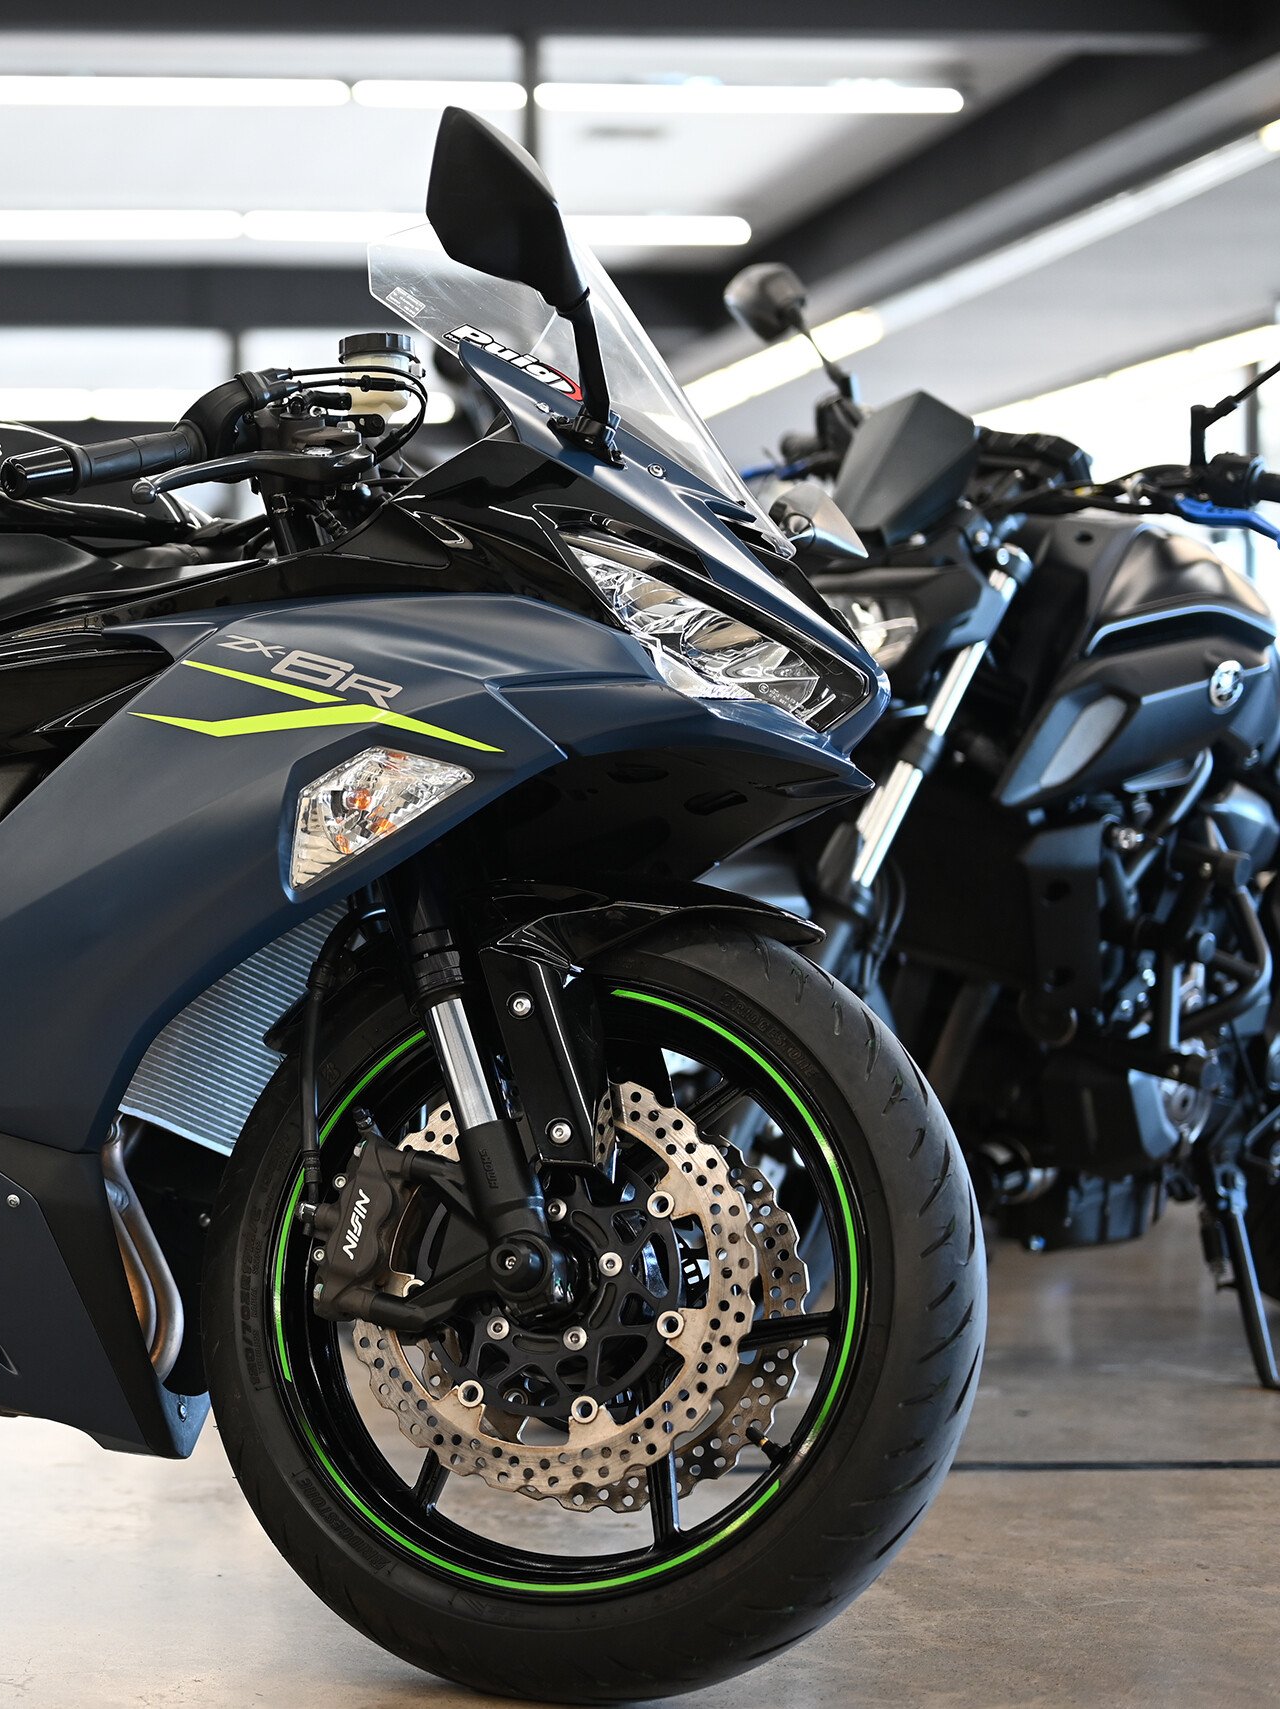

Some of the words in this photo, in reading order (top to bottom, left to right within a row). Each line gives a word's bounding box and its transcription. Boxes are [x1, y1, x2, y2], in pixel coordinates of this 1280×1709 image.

[216, 634, 403, 710] ZX-6R
[342, 1188, 371, 1261] NISSIN
[296, 1477, 391, 1574] BRIDGESTONE
